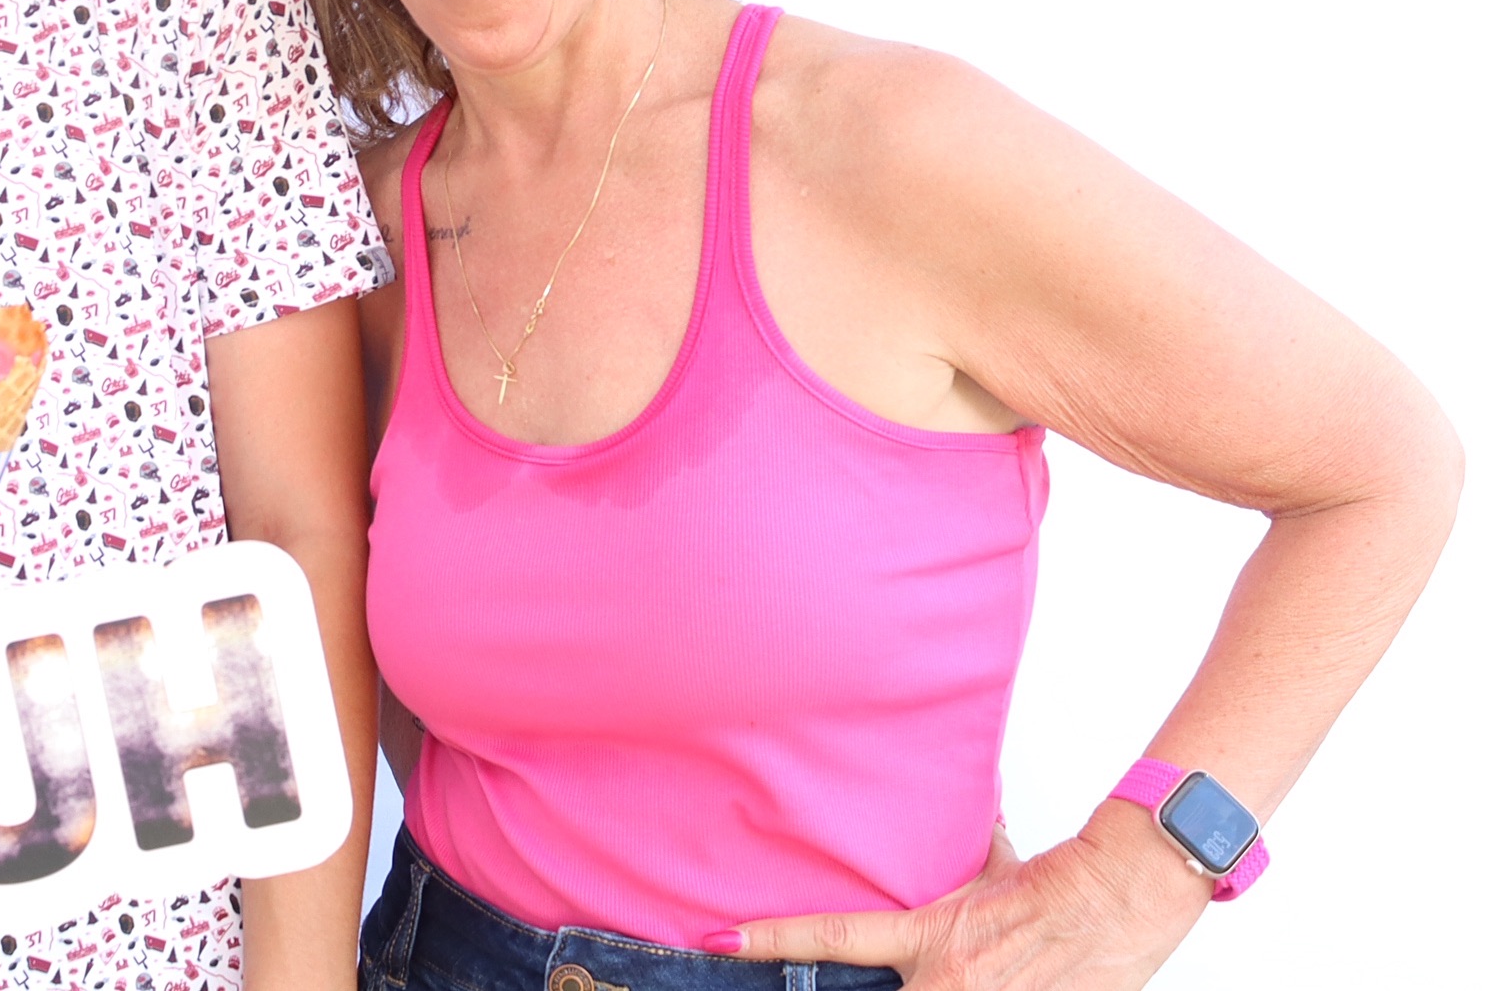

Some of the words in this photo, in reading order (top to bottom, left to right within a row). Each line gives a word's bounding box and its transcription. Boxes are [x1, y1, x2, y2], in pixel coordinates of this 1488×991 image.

[232, 94, 248, 111] 37
[296, 169, 310, 186] 37
[126, 196, 142, 213] 37
[12, 207, 28, 223] 37
[193, 207, 208, 223] 37
[265, 281, 282, 297] 37
[82, 303, 98, 319] 37
[150, 401, 166, 416] 37
[36, 413, 49, 429] 37
[100, 509, 116, 524] 37
[142, 909, 156, 927] 37
[26, 931, 42, 947] 37
